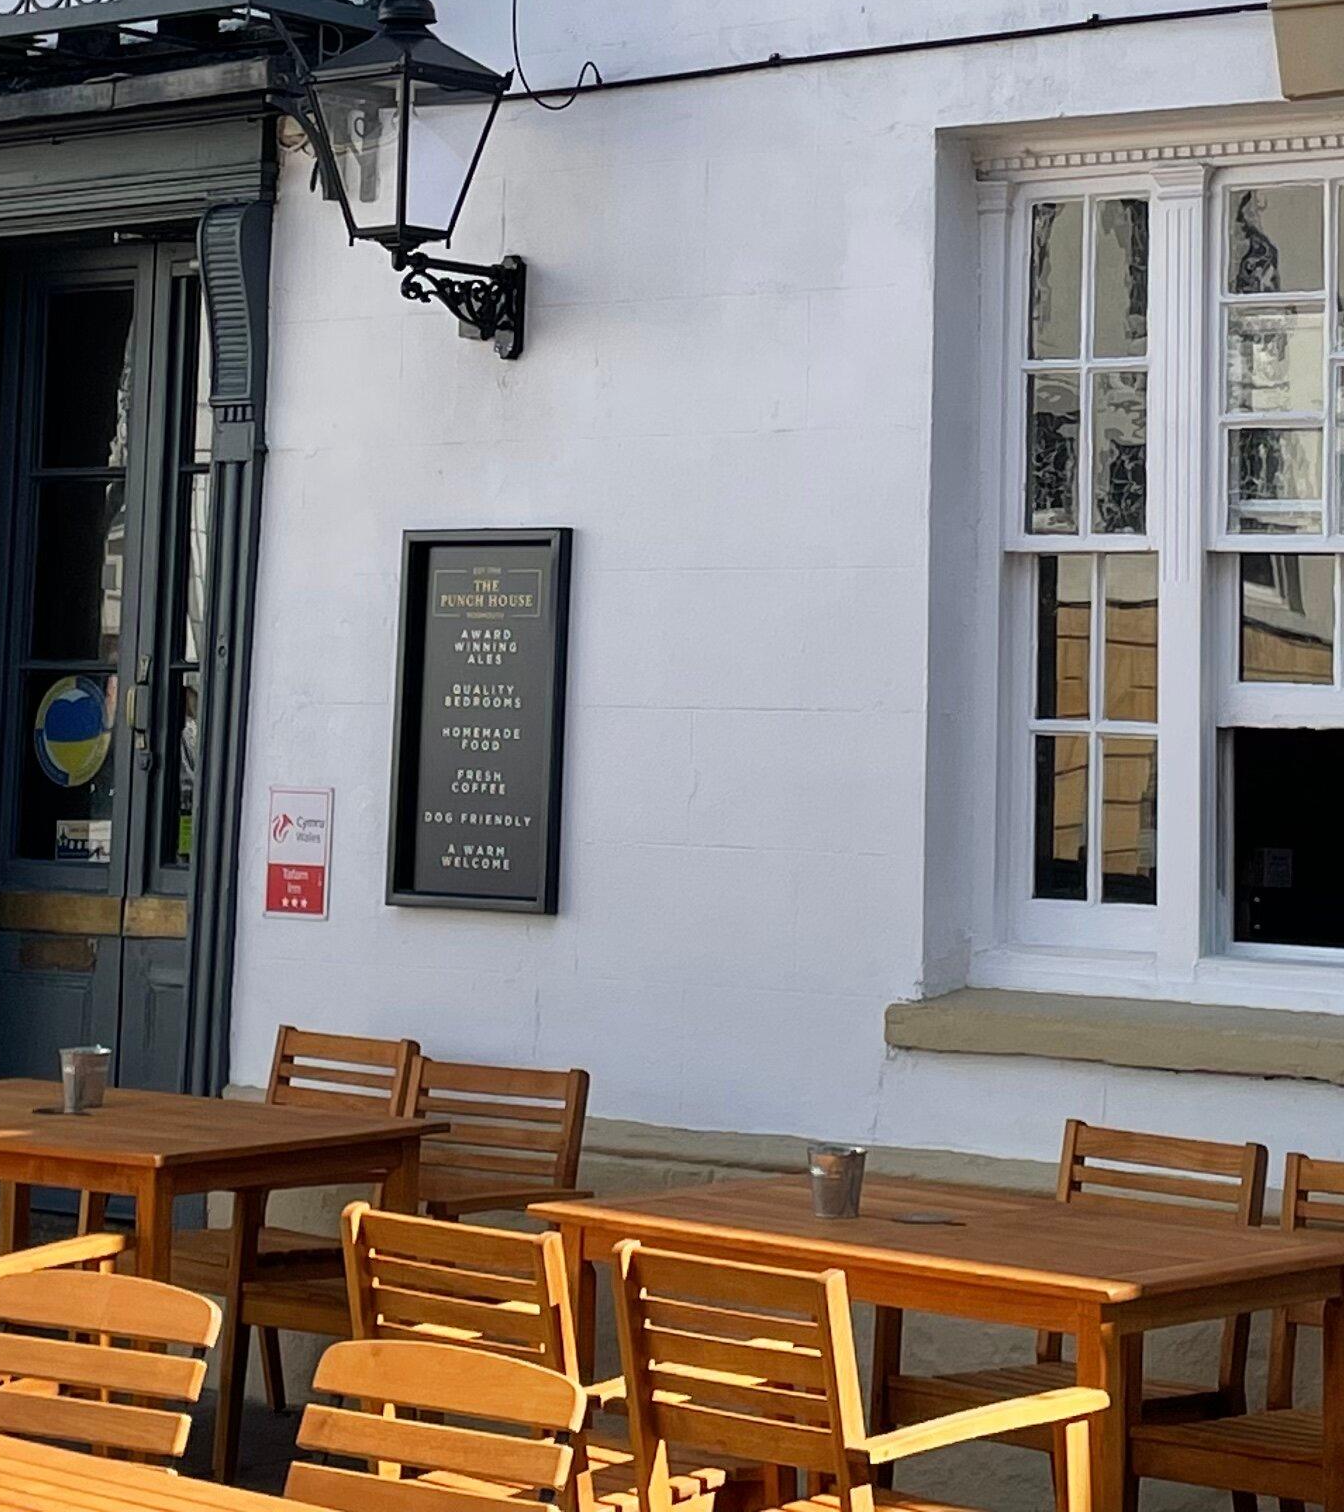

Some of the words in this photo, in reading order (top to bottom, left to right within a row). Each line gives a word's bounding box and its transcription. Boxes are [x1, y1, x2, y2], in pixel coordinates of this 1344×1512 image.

[473, 579, 500, 592] THE
[440, 595, 484, 607] PUNCH
[488, 595, 534, 607] HOUSE
[461, 629, 512, 640] AWARD
[454, 642, 517, 653] WINNING
[467, 654, 502, 665] ALES
[453, 684, 515, 696] QUALITY
[444, 696, 521, 708] BEDROOMS
[442, 727, 521, 740] HOMEMADE
[461, 738, 500, 751] FOOD
[457, 769, 501, 782] FRESH
[451, 782, 506, 795] COFFEE
[424, 811, 453, 824] DOG
[460, 813, 532, 827] FRIENDLY
[447, 843, 456, 855] A
[463, 845, 506, 857] WARM
[441, 856, 511, 871] WELCOME
